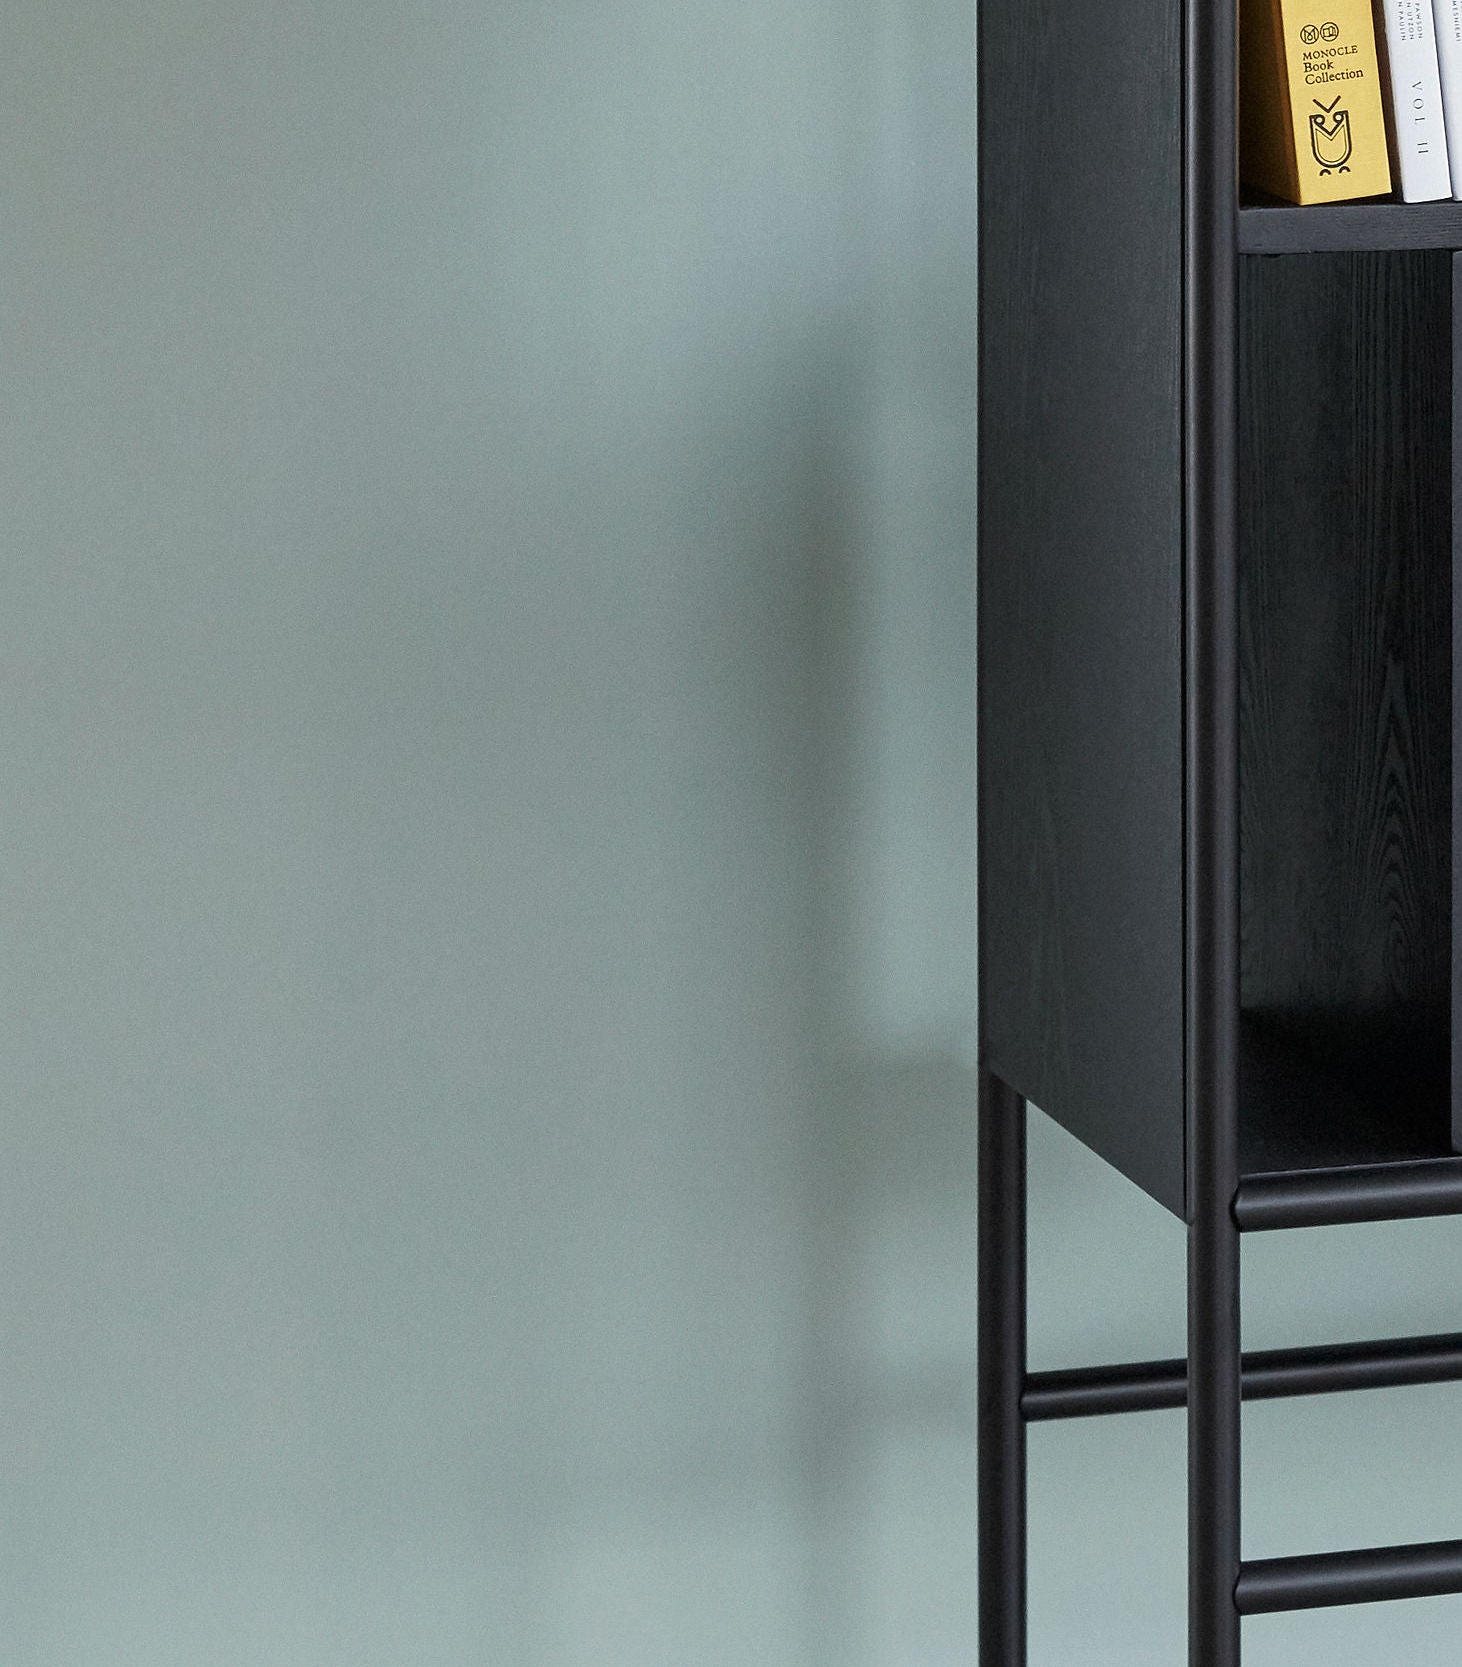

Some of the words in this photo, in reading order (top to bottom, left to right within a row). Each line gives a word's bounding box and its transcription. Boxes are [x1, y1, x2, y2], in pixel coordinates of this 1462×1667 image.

[1302, 45, 1359, 61] MONOCLE
[1303, 59, 1334, 73] Book
[1305, 69, 1364, 85] Collection
[1410, 81, 1426, 126] VOL
[1417, 142, 1429, 154] II
